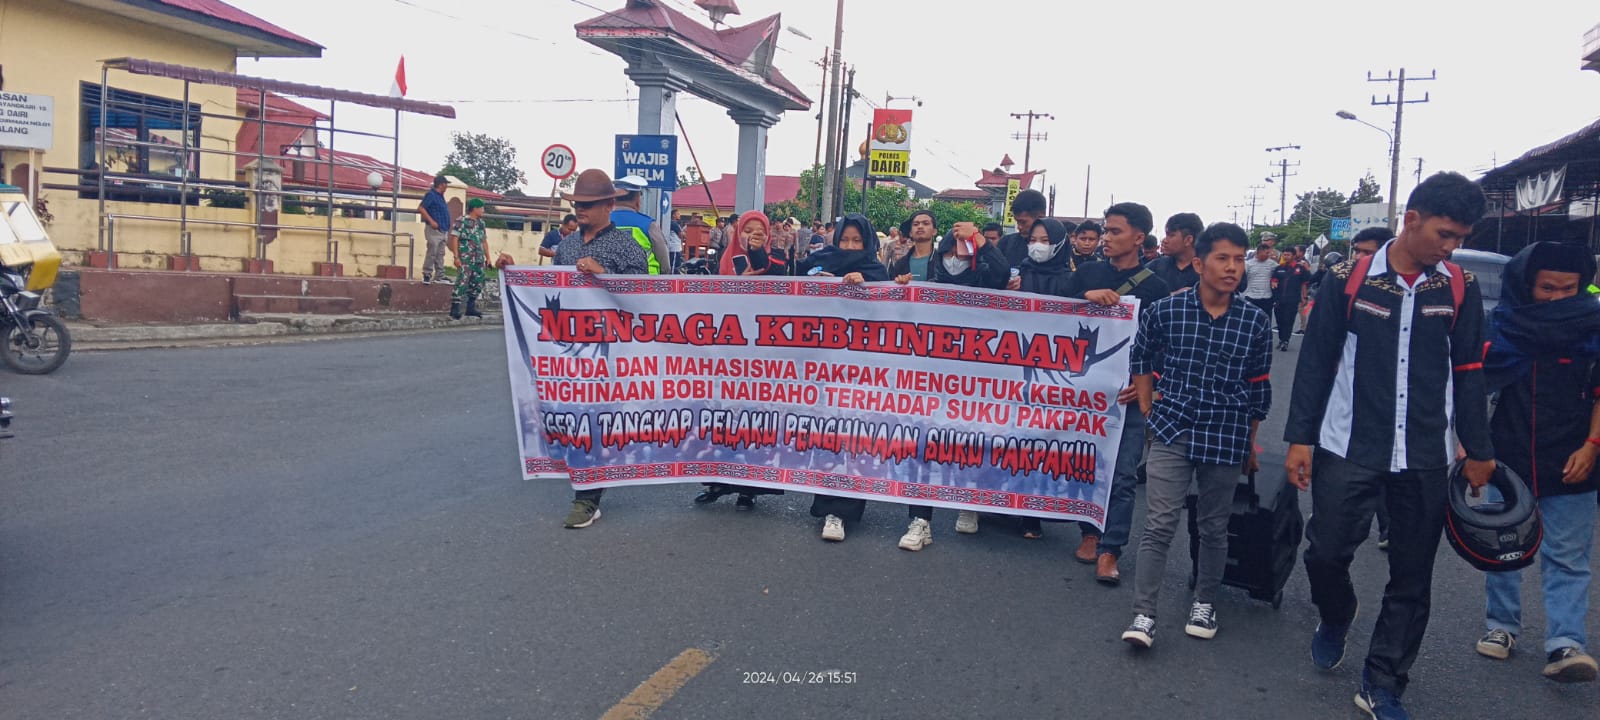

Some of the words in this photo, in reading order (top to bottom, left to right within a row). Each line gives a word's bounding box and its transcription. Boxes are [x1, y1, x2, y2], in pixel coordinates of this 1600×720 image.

[7, 109, 28, 118] DAIRI
[546, 152, 563, 169] 20
[622, 152, 669, 166] WAJIB
[871, 160, 906, 173] DAIRI
[537, 308, 748, 346] MENJAGA
[755, 315, 1089, 374] KEBHINEKAAN
[616, 355, 658, 377] DAN
[665, 356, 799, 380] MAHASISWA
[804, 361, 888, 388] PAKPAK
[896, 369, 1024, 402] MENGUTUK
[1030, 383, 1108, 412] KERAS
[662, 379, 713, 400] BOBI
[721, 380, 818, 405] NAIBAHO
[825, 386, 940, 417] TERHADAP
[946, 399, 1011, 425] SUKU
[1016, 406, 1107, 437] PAKPAK
[598, 408, 694, 451] TANGKAP
[700, 409, 779, 450] PELAKU
[785, 412, 920, 465] PENGHINAAN
[924, 428, 985, 469] SUKU
[990, 436, 1096, 485] PAKPAK!!!
